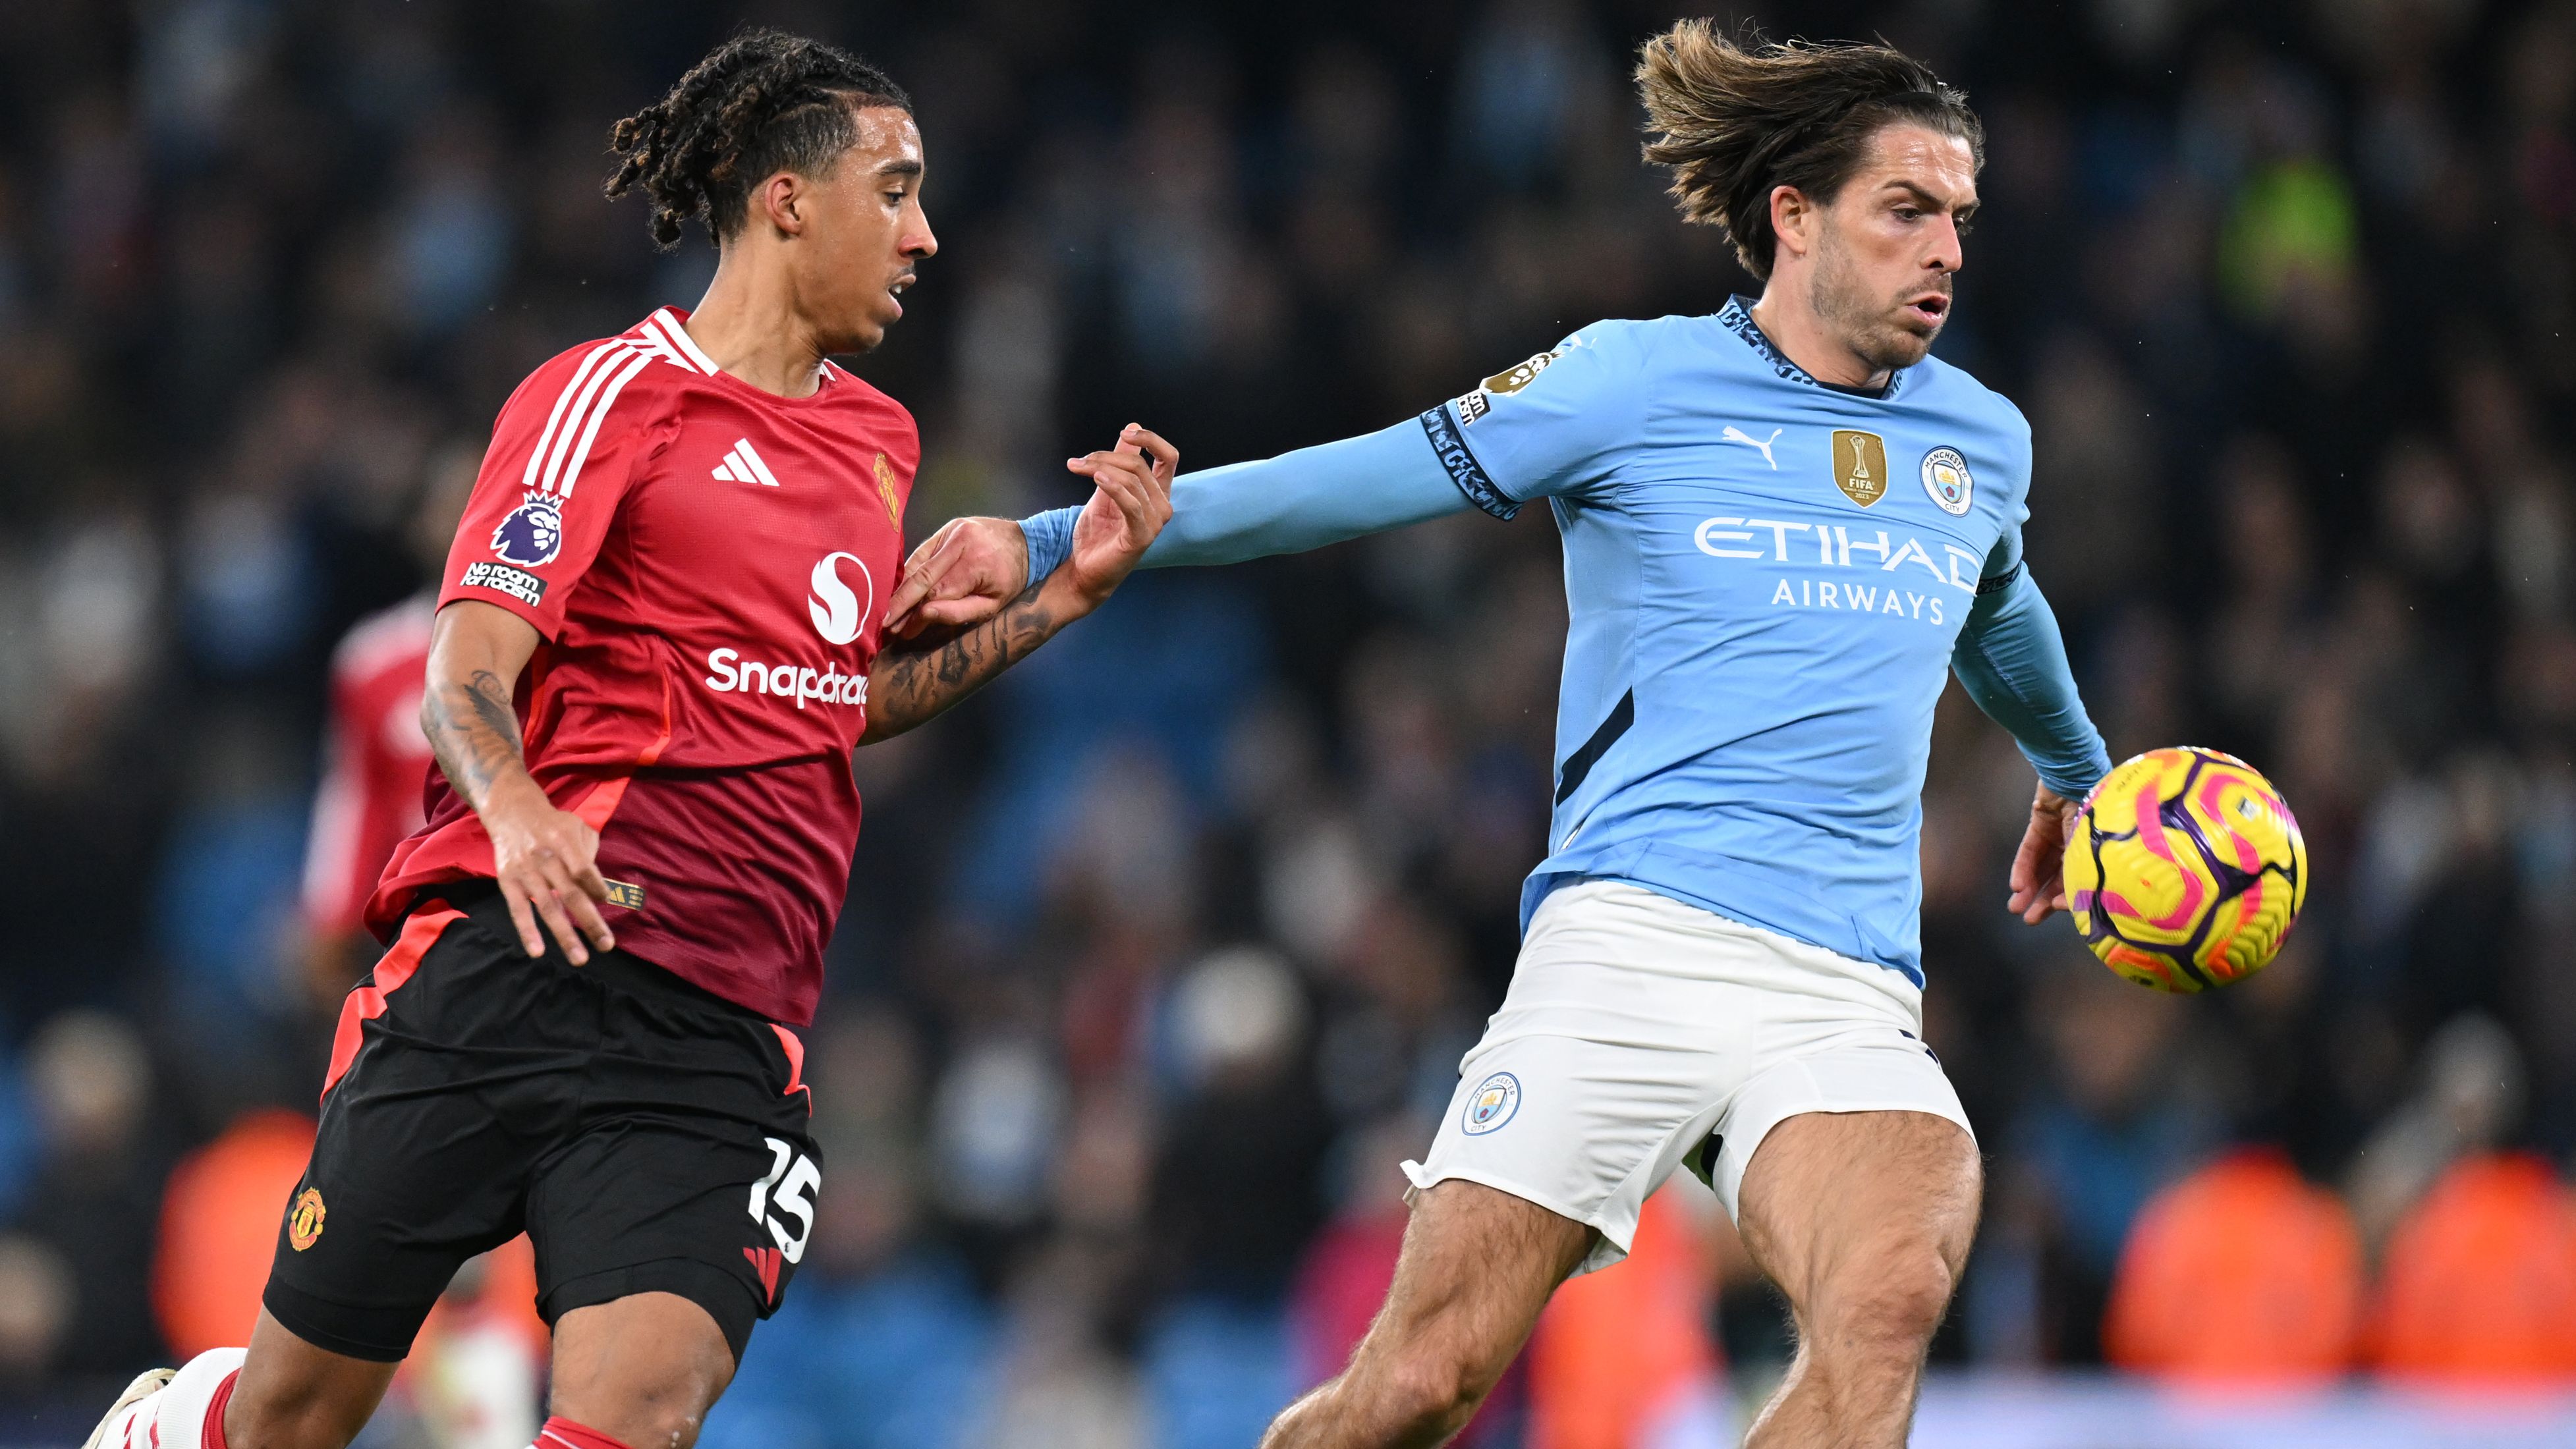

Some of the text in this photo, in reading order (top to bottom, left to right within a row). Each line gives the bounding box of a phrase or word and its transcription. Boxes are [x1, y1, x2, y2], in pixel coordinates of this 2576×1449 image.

[1925, 452, 1967, 478] MANCHESTER
[1849, 478, 1873, 491] FIFA
[1694, 517, 1978, 597] ETIHAD
[460, 575, 540, 607] for racism
[466, 562, 538, 591] No room
[1771, 579, 1943, 625] AIRWAYS
[748, 1137, 821, 1264] 15
